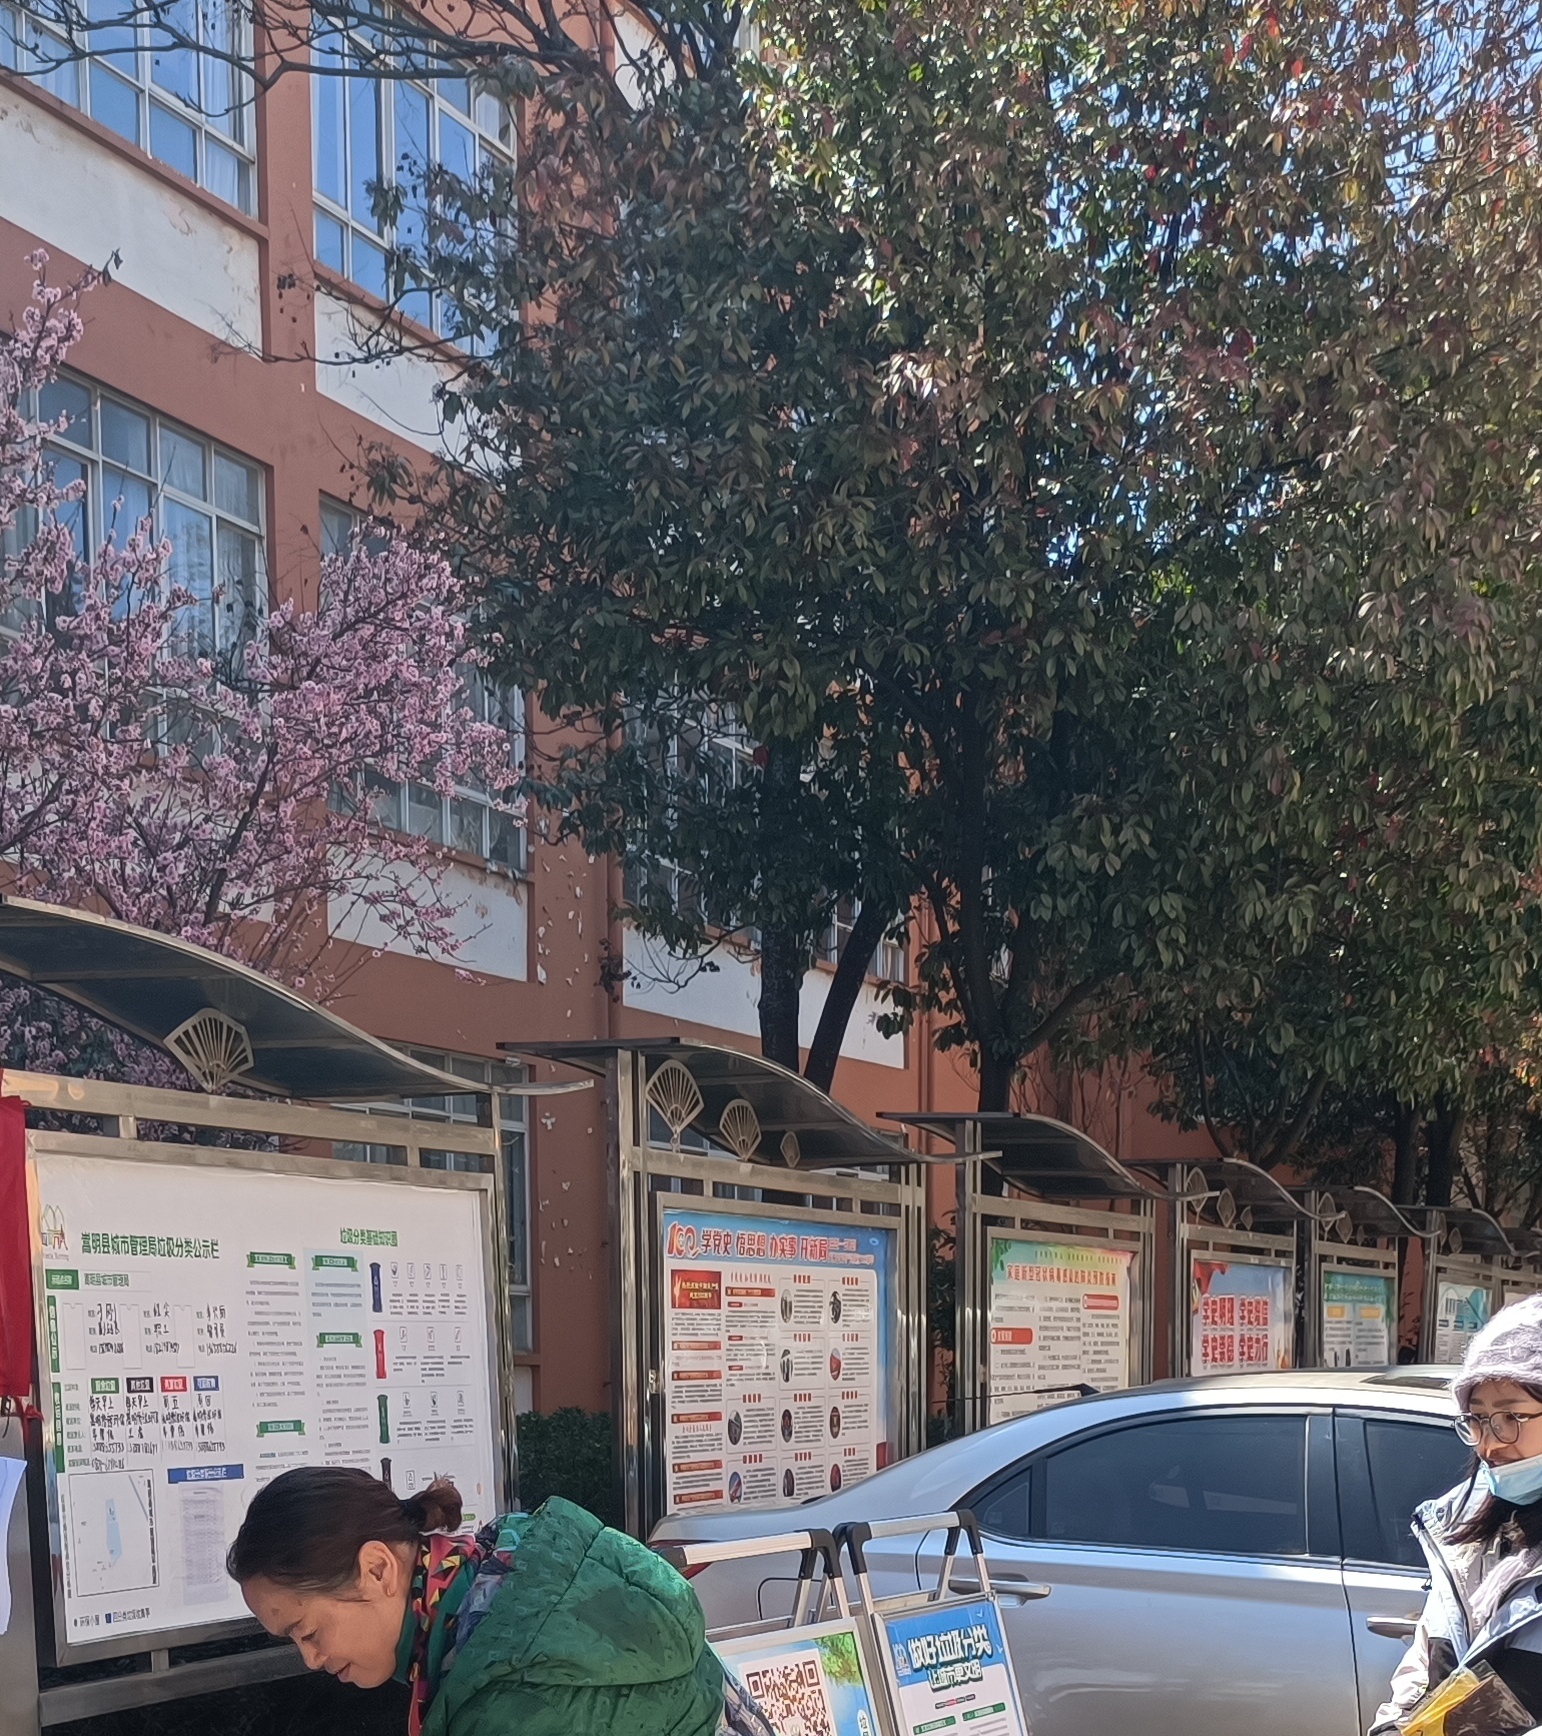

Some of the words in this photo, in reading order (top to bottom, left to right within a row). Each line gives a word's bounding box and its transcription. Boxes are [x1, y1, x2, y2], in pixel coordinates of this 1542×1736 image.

[81, 1231, 220, 1259] 嵩明县城市管理局垃圾分类公示栏
[701, 1229, 732, 1255] 学党史
[736, 1232, 766, 1257] 悟思想
[769, 1235, 796, 1259] 办实事
[800, 1237, 828, 1262] 开新局
[1202, 1296, 1234, 1326] 学史明理
[1239, 1334, 1268, 1362] 学史力行
[906, 1624, 993, 1670] 做好垃圾分类
[928, 1659, 983, 1690] 让城市更文明
